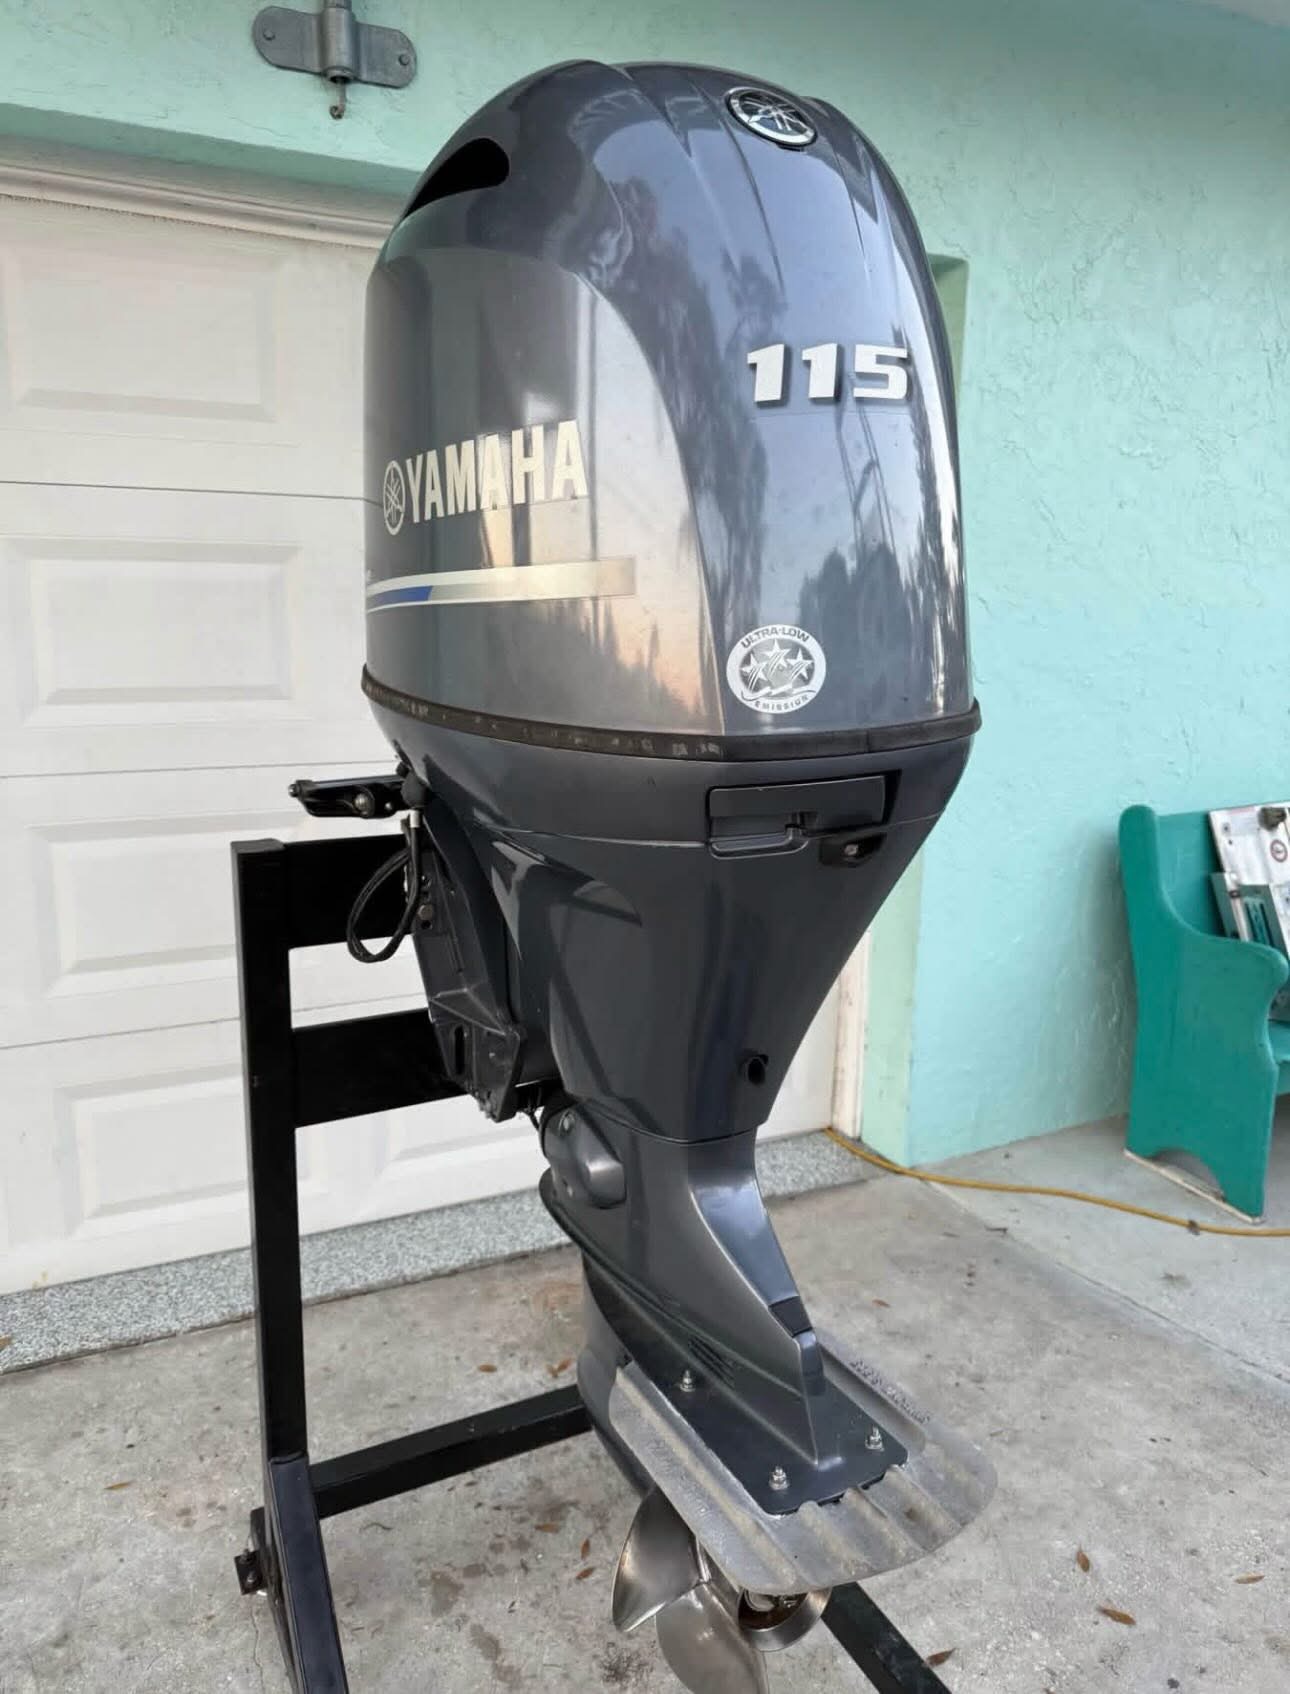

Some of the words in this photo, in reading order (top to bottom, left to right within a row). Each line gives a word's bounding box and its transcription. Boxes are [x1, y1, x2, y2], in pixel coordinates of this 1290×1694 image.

[747, 343, 907, 402] 115
[405, 419, 588, 523] YAMAHA
[754, 695, 809, 711] EMISSION
